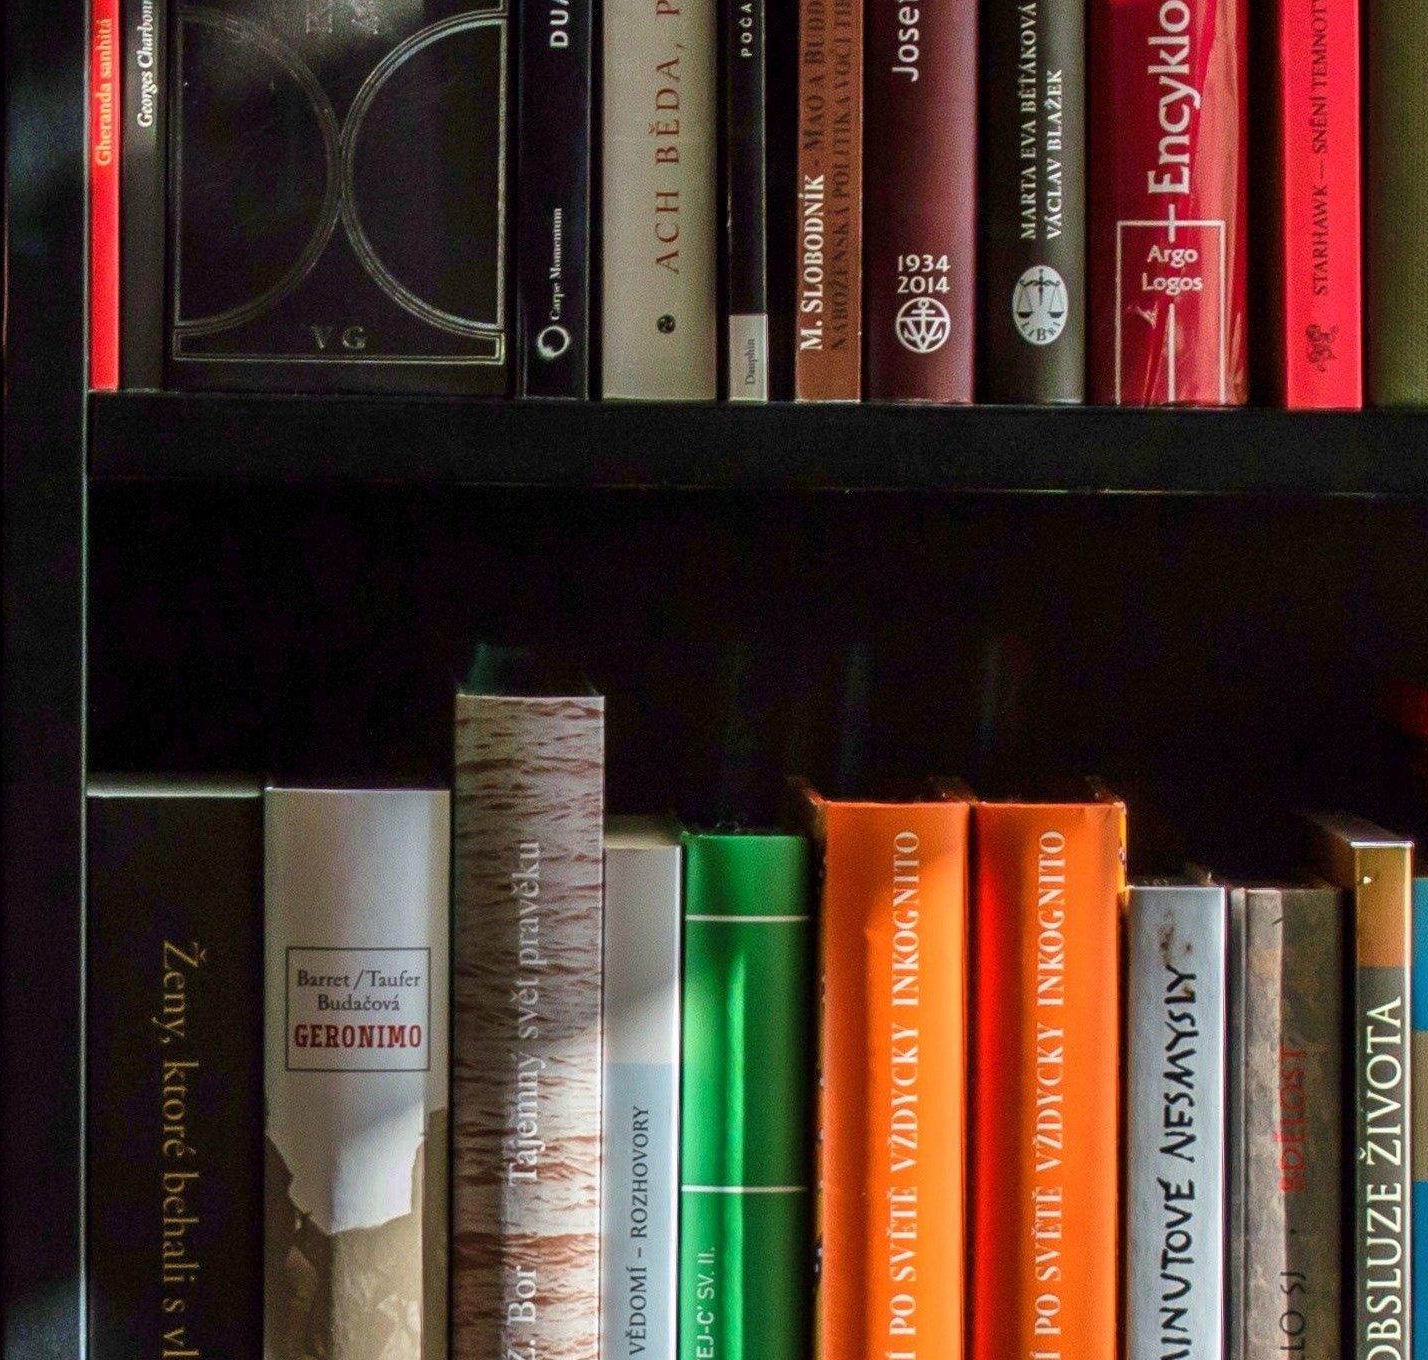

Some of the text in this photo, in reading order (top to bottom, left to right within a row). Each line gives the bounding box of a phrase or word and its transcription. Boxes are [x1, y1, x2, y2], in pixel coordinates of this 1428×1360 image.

[647, 43, 687, 274] ACH BĚDA,
[1020, 120, 1037, 239] MARTA EVA
[1043, 70, 1062, 239] VÁCLAV BLAŽEK
[896, 276, 951, 293] 2014
[897, 254, 951, 272] 1934
[1142, 273, 1203, 296] Logos
[1147, 245, 1198, 268] Argo
[890, 830, 920, 1007] INKOGNITO
[153, 940, 207, 1044] Ženy,
[295, 1024, 422, 1048] GERONIMO
[317, 993, 400, 1011] Budačová
[162, 1059, 200, 1158] ktoré
[886, 1021, 919, 1172] VŽDYCKY
[1358, 996, 1402, 1166] ŽIVOTA
[162, 1171, 200, 1283] behali
[885, 1185, 918, 1282] SVĚTĚ
[162, 1299, 190, 1313] s
[888, 1293, 918, 1336] PO
